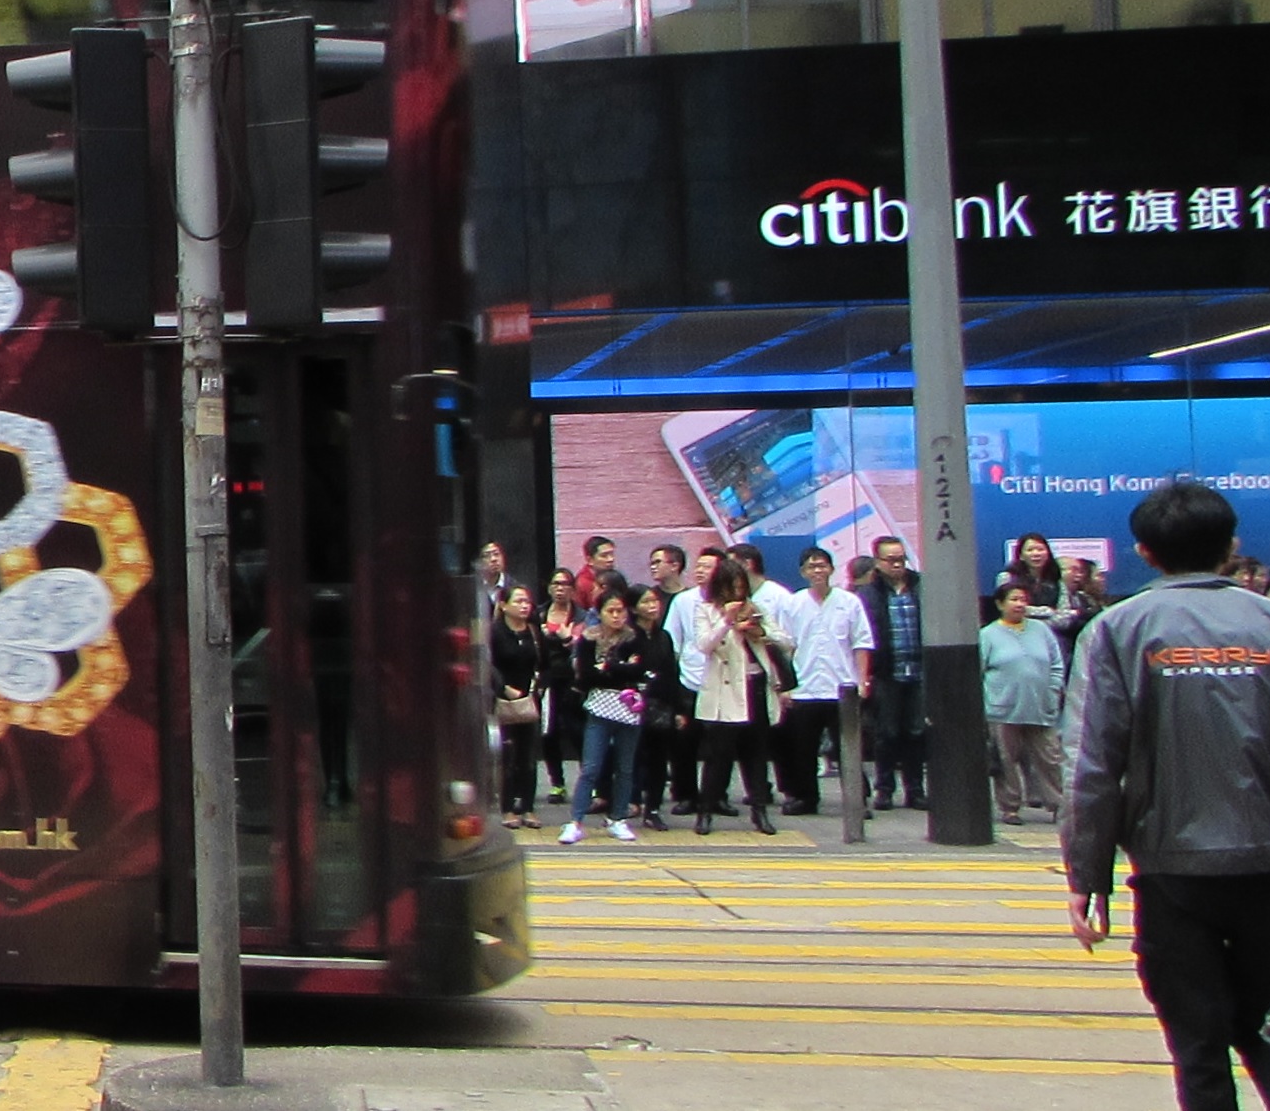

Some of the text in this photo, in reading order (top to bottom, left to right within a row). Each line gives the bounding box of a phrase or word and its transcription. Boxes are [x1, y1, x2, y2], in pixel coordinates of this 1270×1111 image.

[759, 179, 1035, 248] citibnk
[999, 474, 1038, 495] Citi
[1043, 475, 1103, 497] Hong
[1175, 470, 1270, 491] Fceboo
[1162, 666, 1257, 677] EXPRESS
